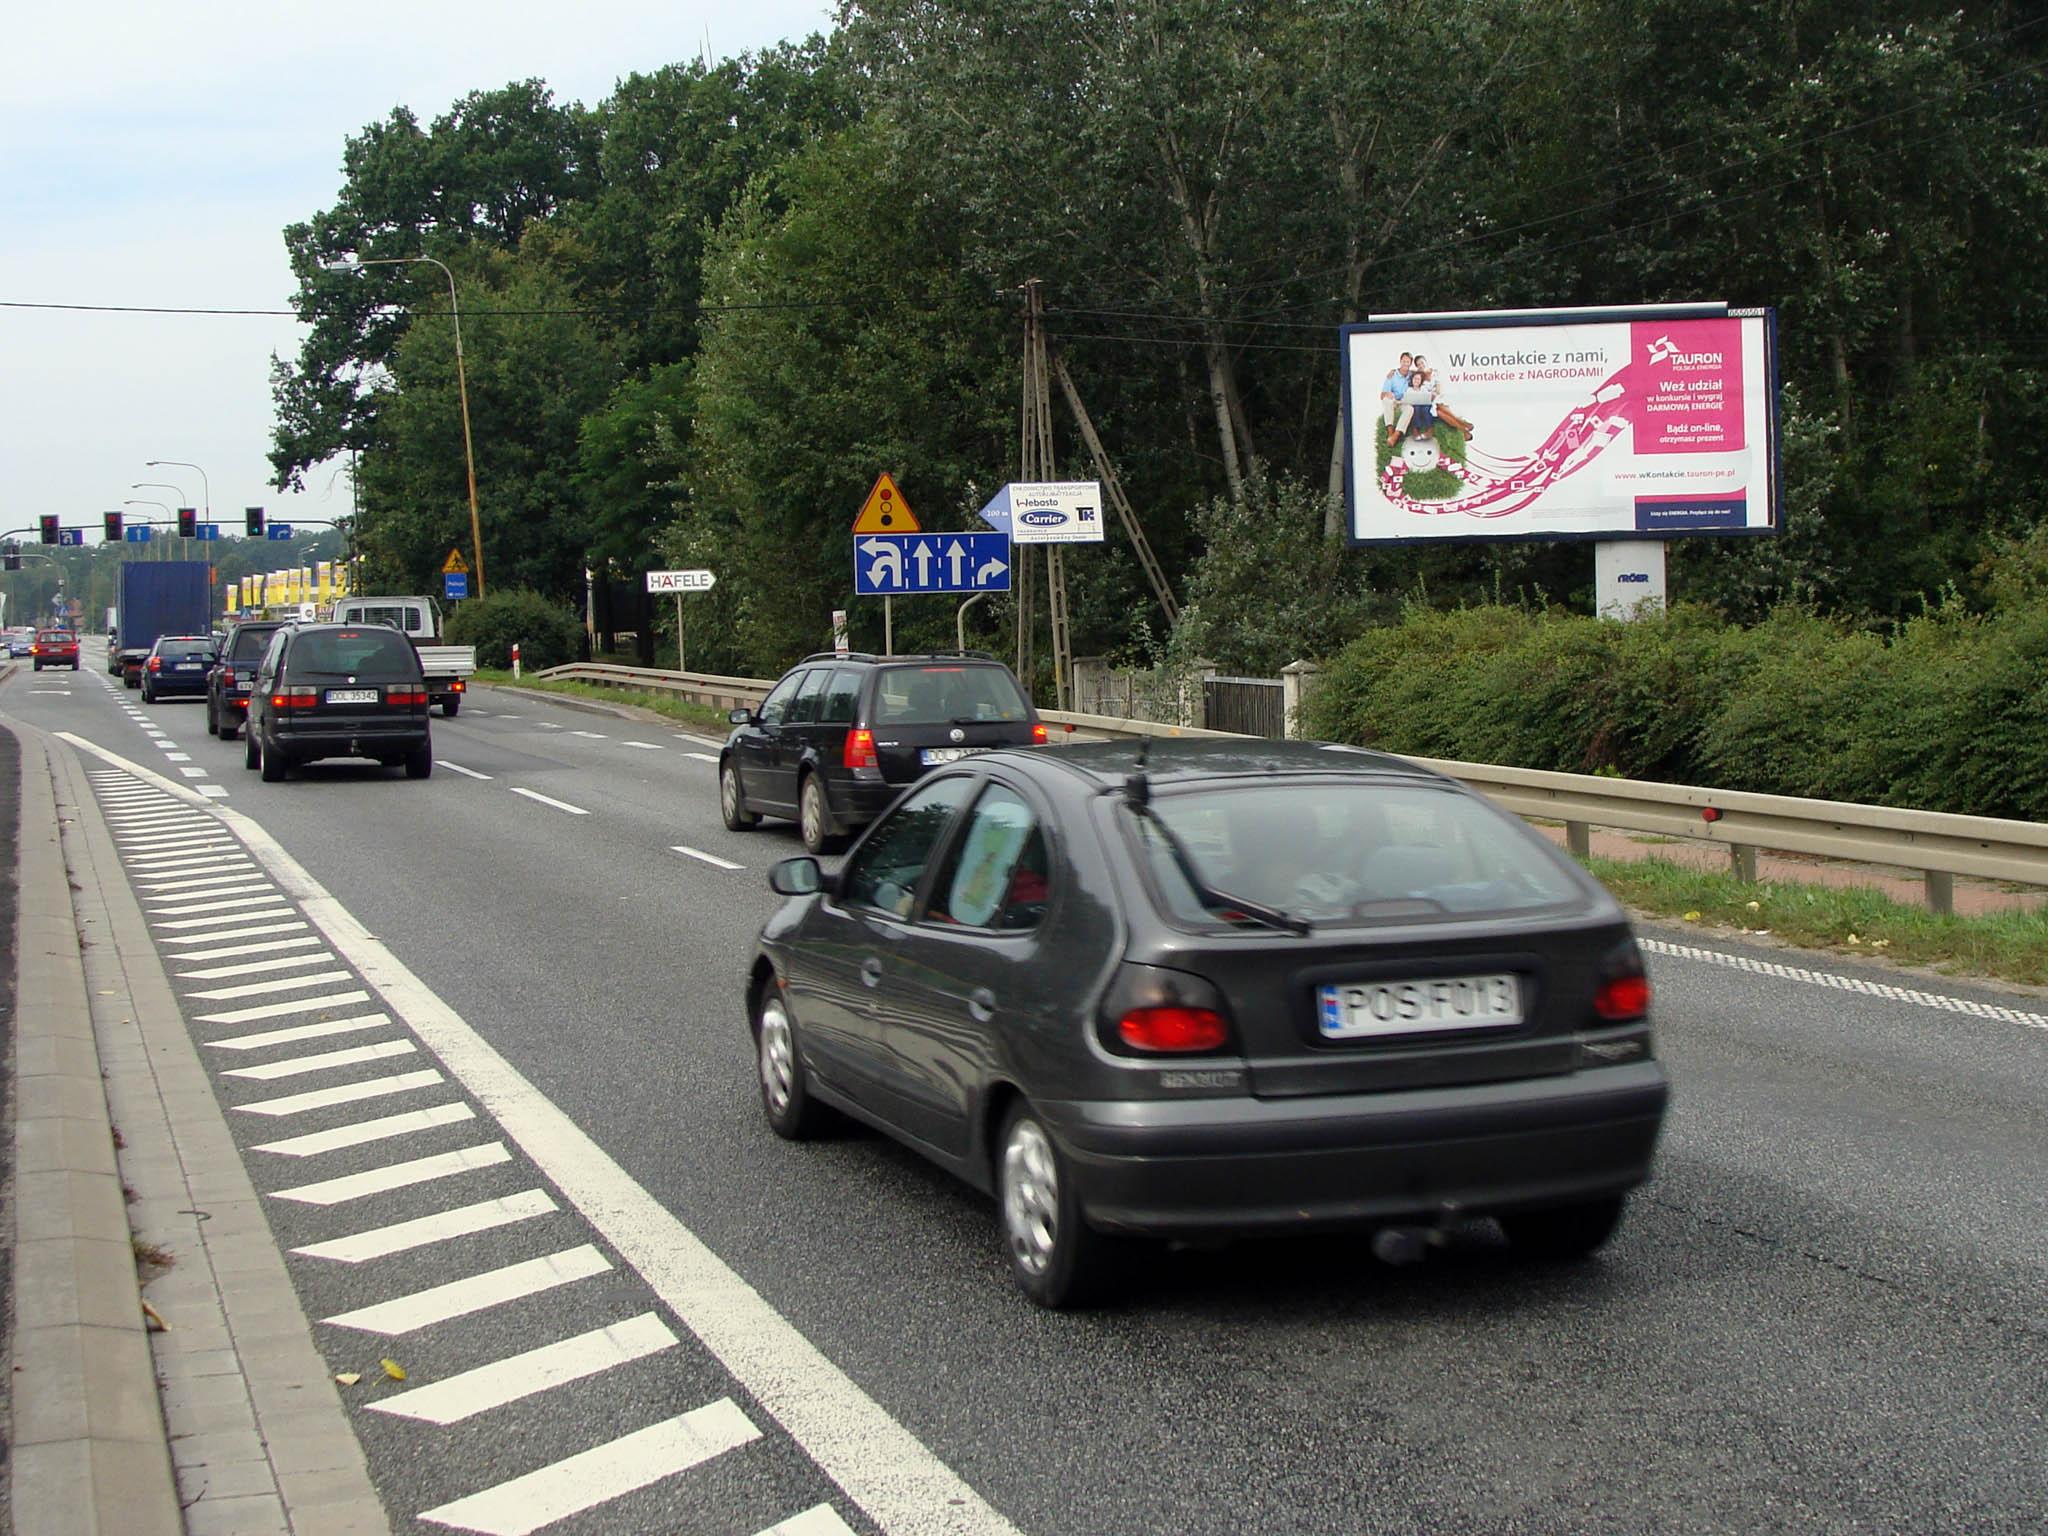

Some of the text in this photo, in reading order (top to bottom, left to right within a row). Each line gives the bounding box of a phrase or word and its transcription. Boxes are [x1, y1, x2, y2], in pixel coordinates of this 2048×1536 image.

[1450, 348, 1608, 367] W kontakcie z nami,
[1670, 353, 1723, 365] TAURON
[1450, 374, 1460, 382] w
[1463, 370, 1515, 382] kontakcie
[1527, 367, 1604, 380] NAGRODAMI!
[1688, 379, 1723, 391] udział
[1656, 393, 1691, 402] konkursie
[1697, 392, 1723, 402] wygraj
[1647, 401, 1724, 412] DARMOWĄ ENERGIĘ
[1659, 434, 1724, 444] otrzymasz prezent
[1016, 498, 1059, 507] Webasto
[1026, 514, 1063, 524] Carrier
[650, 573, 709, 588] HÄFELE
[1345, 985, 1421, 1025] POS
